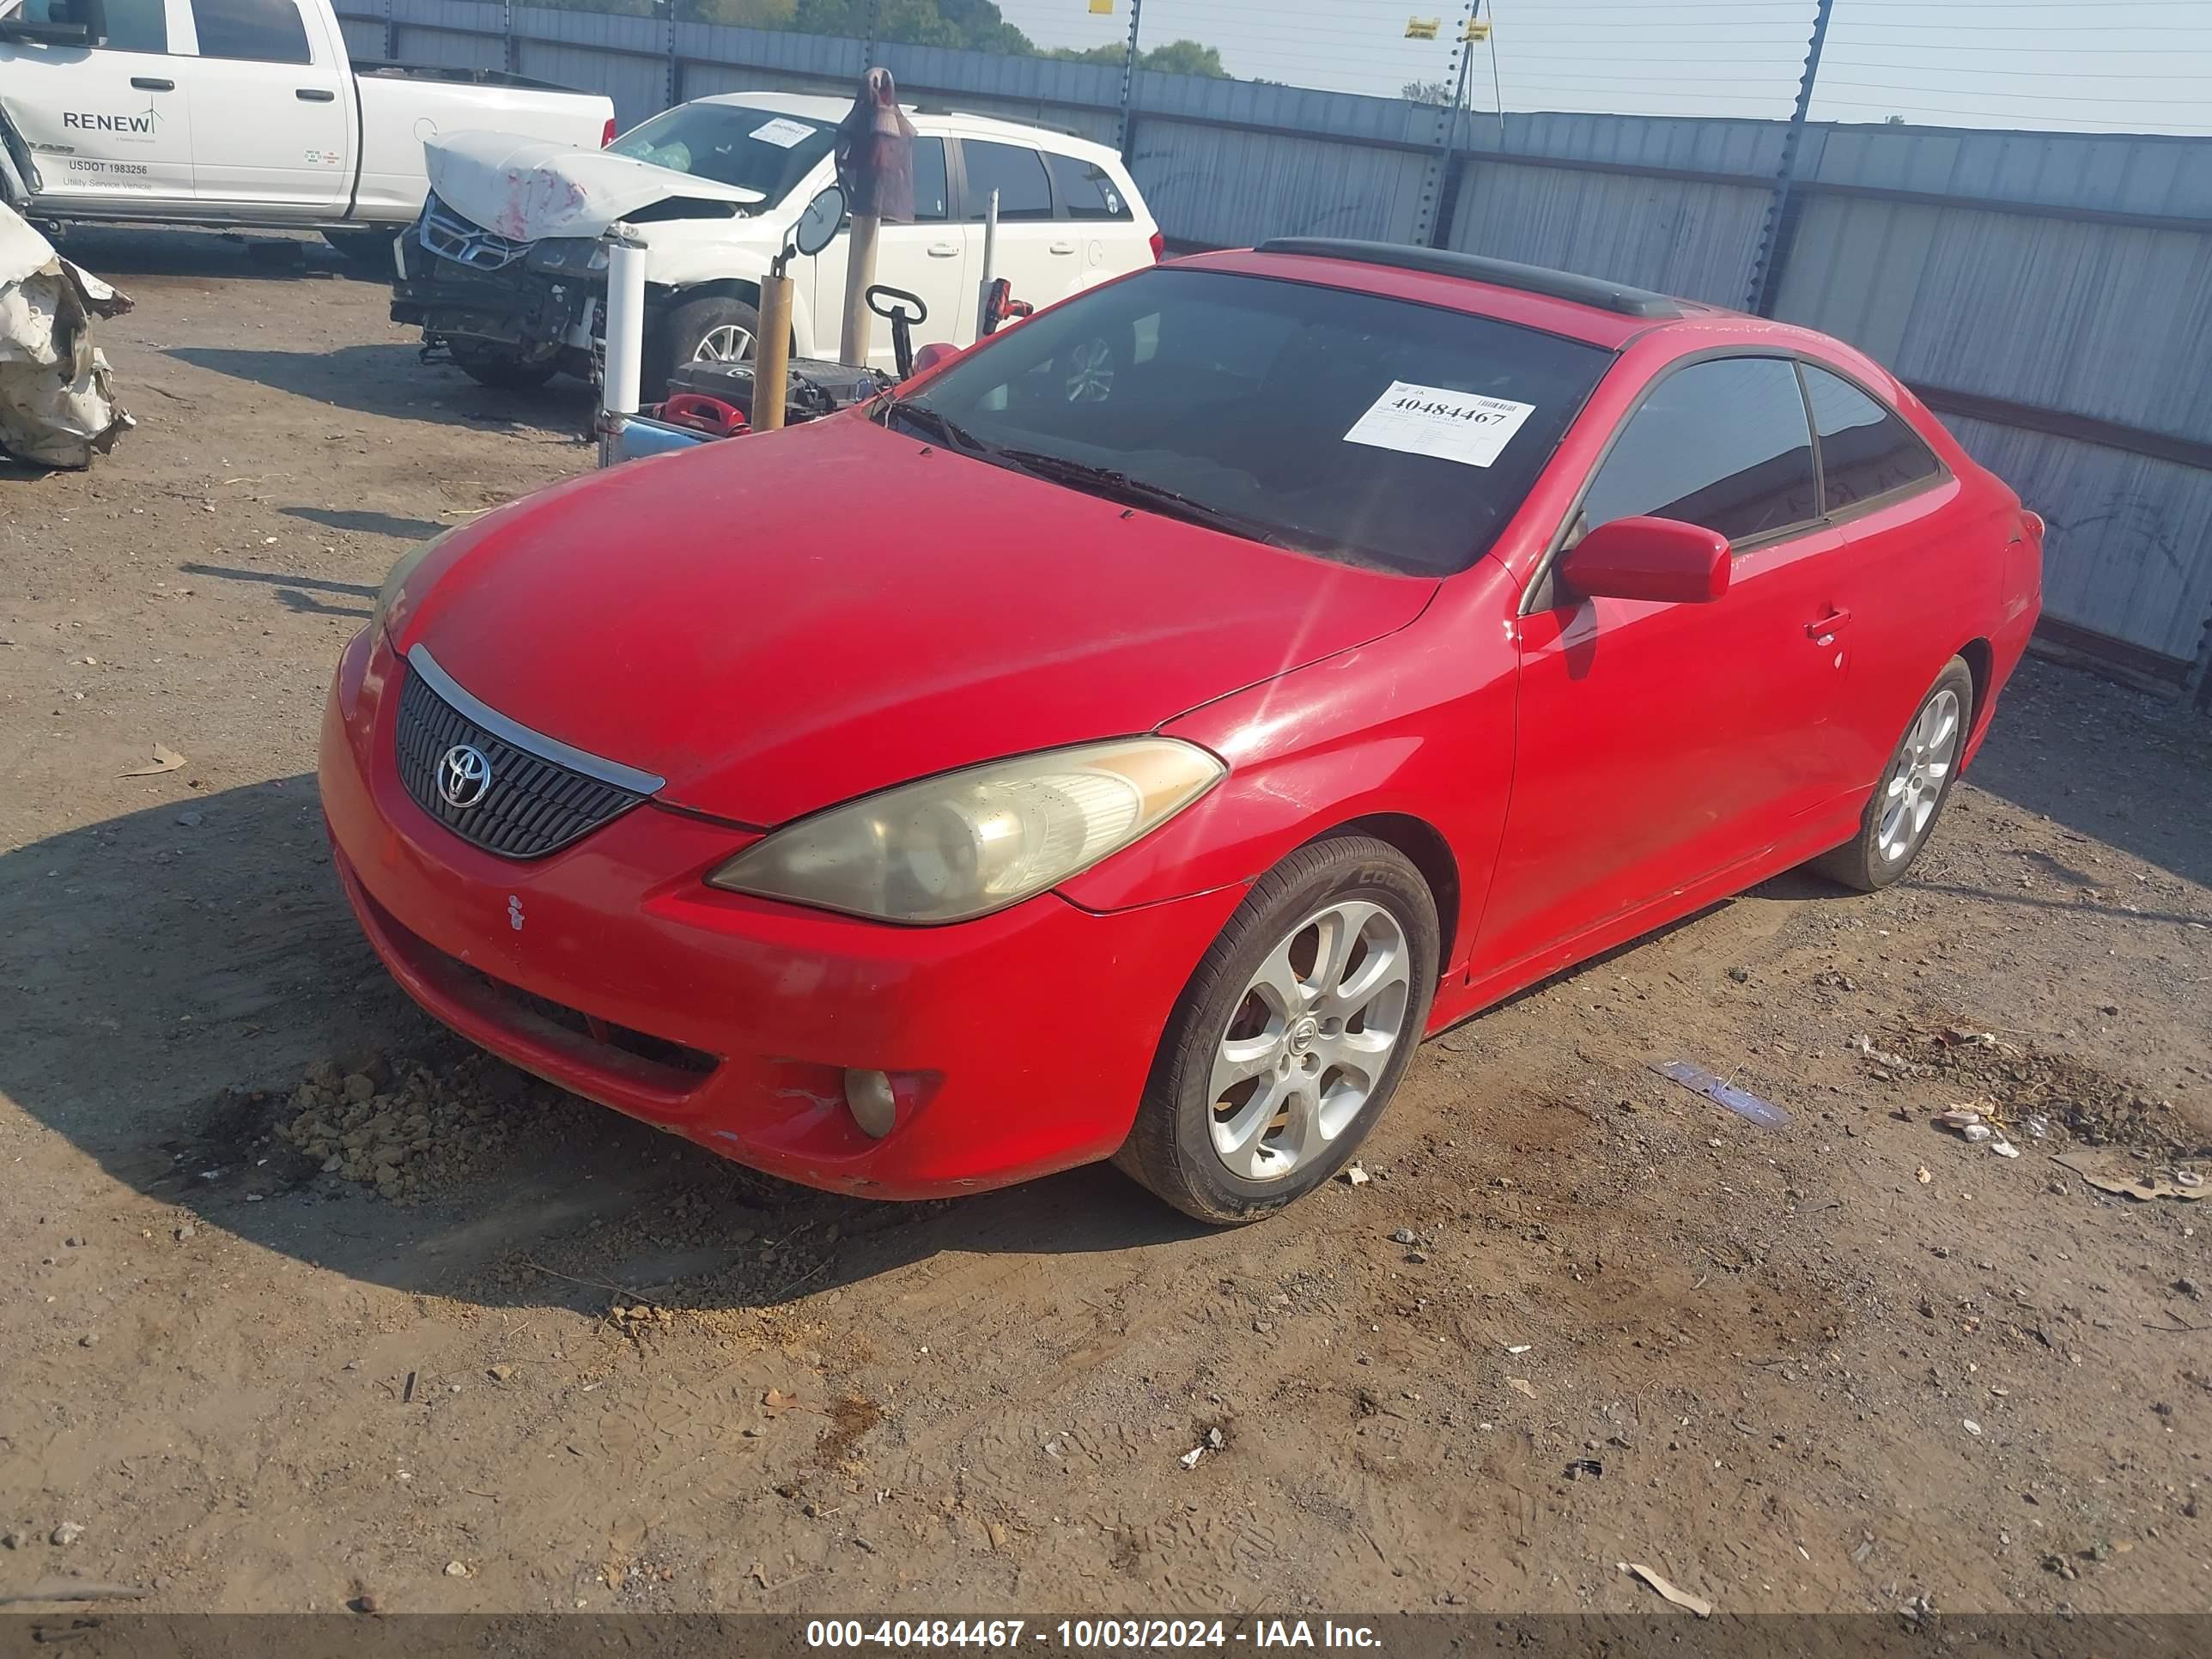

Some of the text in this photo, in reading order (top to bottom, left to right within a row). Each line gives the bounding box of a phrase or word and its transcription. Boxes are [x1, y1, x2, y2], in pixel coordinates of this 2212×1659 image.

[64, 112, 149, 132] RENEW
[69, 160, 148, 174] USDOT 1983256
[63, 177, 152, 191] Utility Service Vehicle
[1391, 397, 1508, 426] 40484467
